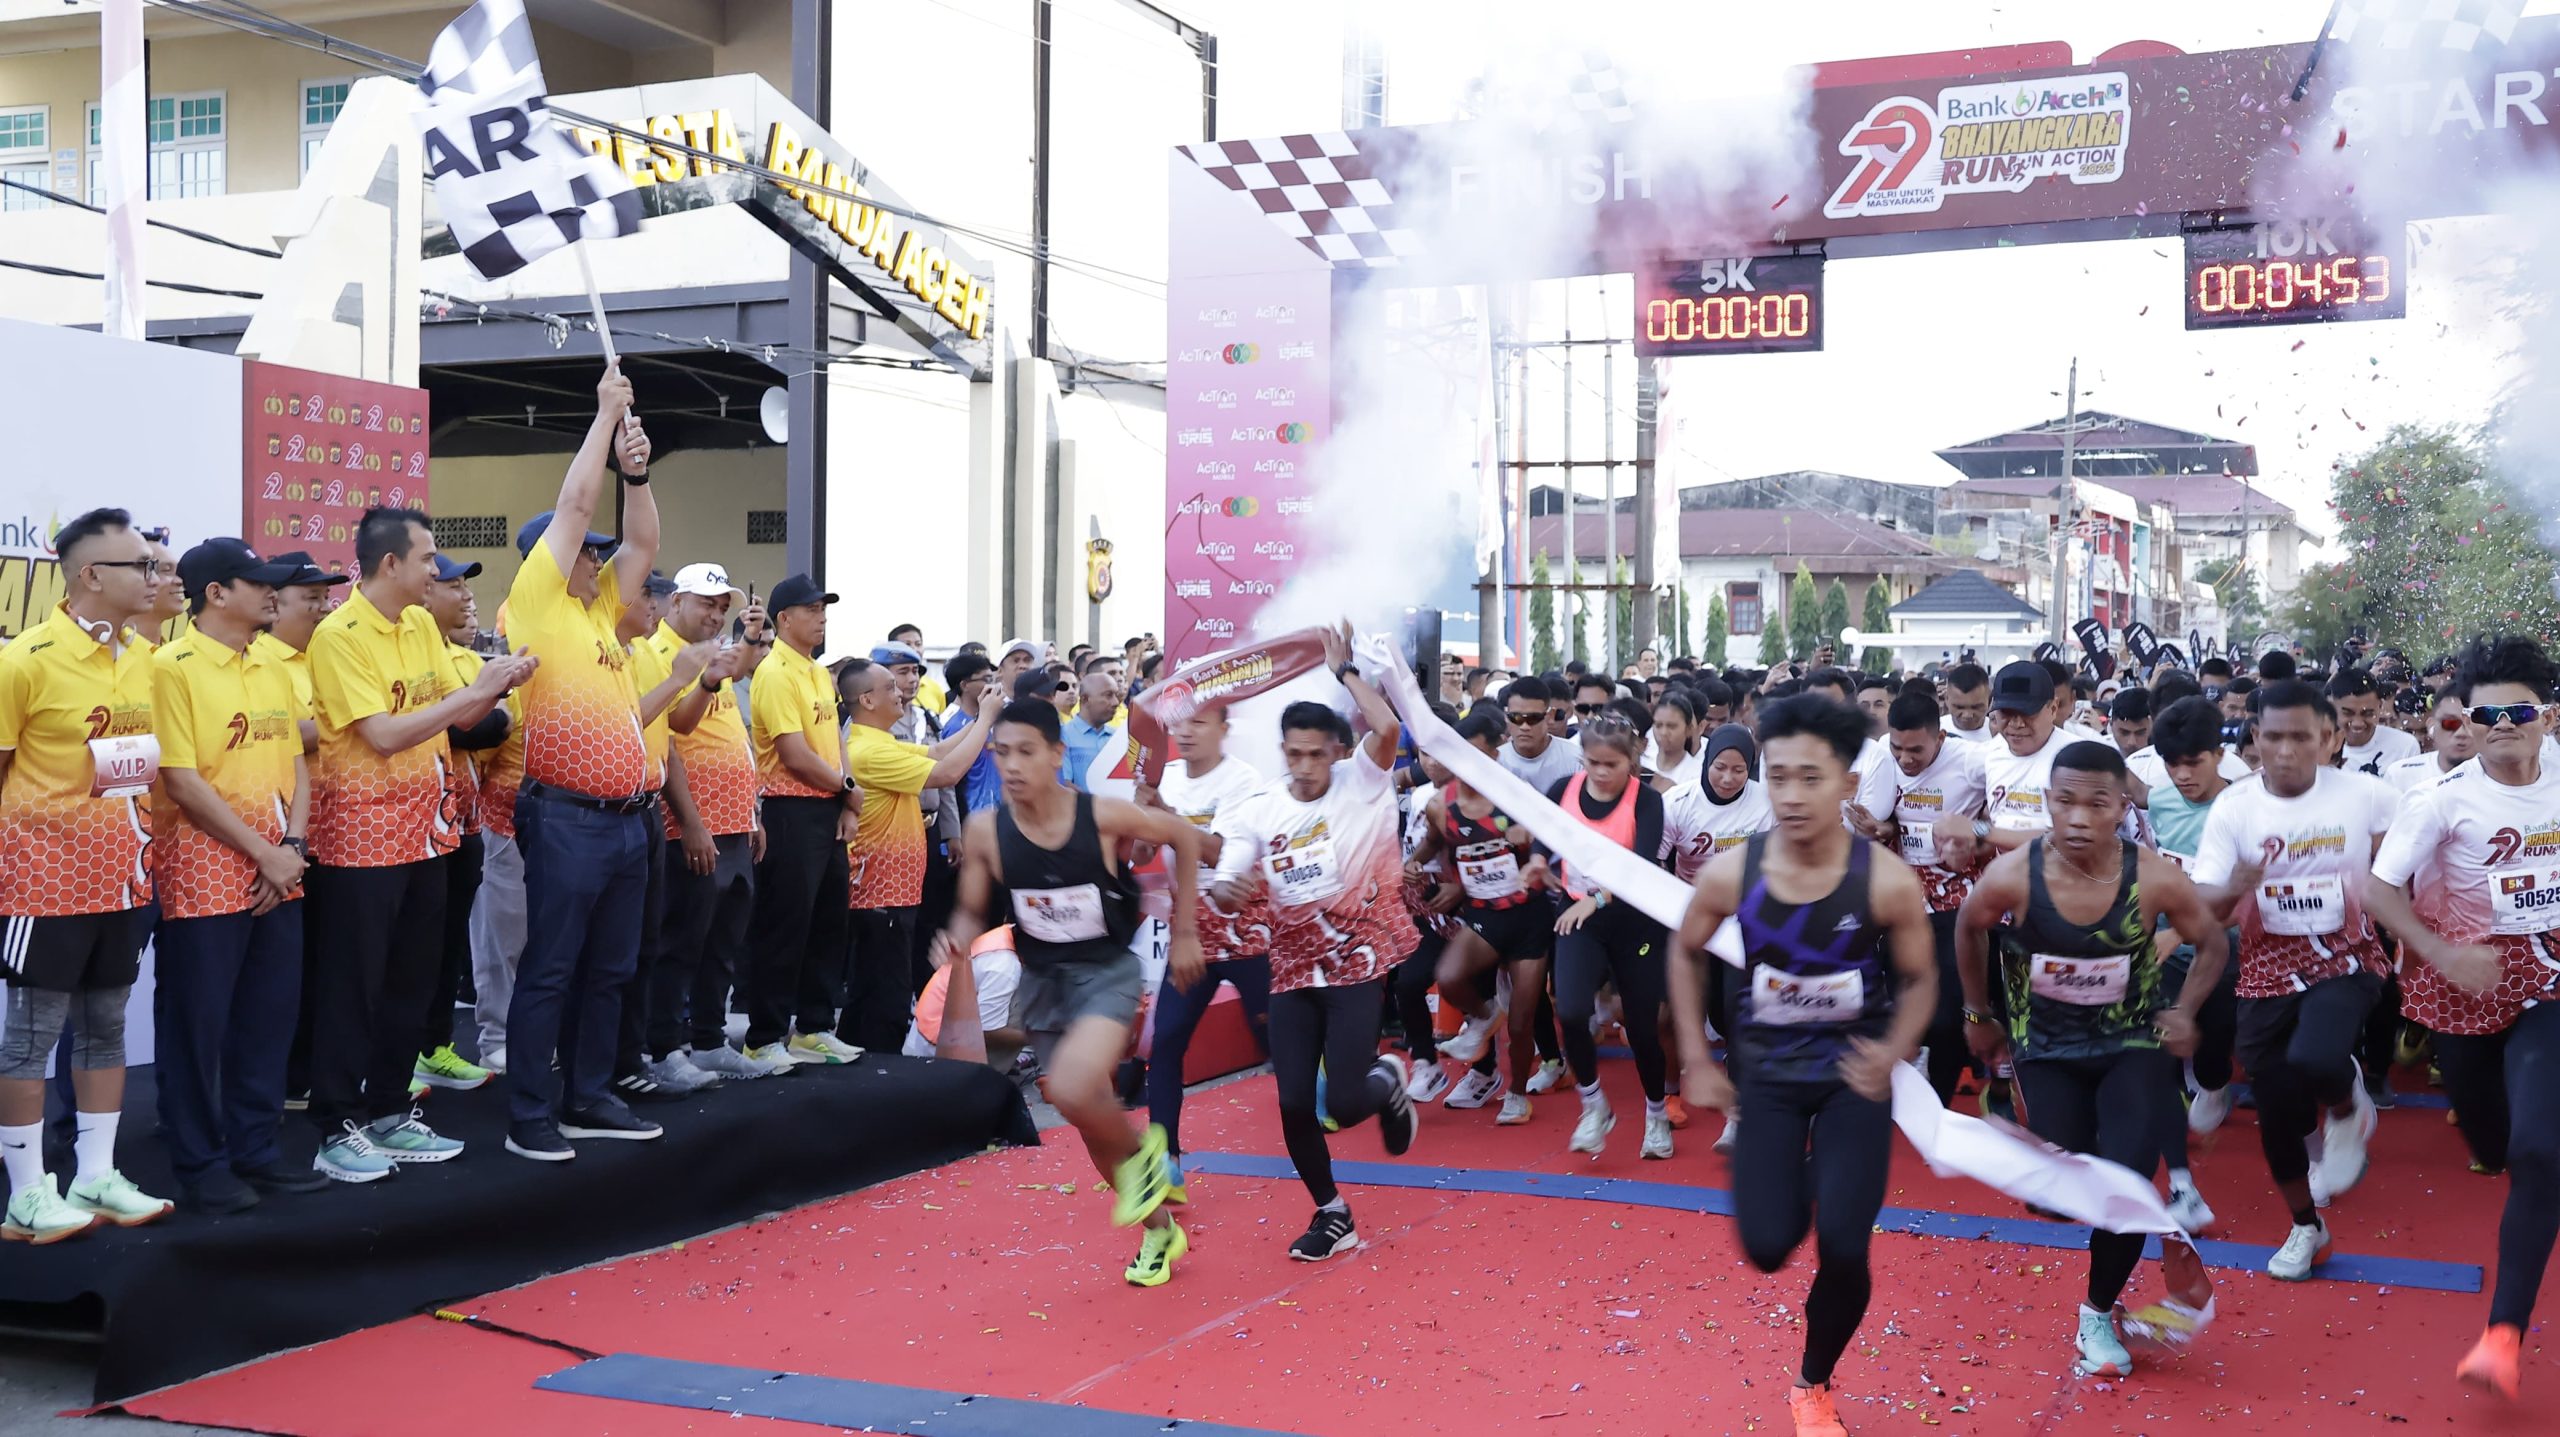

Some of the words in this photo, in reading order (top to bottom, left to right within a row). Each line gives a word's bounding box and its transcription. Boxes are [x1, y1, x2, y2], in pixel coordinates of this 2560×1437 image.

[1948, 96, 2008, 120] Bank
[2036, 87, 2106, 112] Aceh
[2331, 67, 2560, 141] STAR
[2052, 149, 2115, 167] ACTION
[2079, 162, 2115, 177] 2025
[1866, 190, 1897, 200] POLRI
[1899, 187, 1935, 197] UNTUK
[1866, 195, 1936, 208] MASYARAKAT
[764, 121, 895, 270] BANDA
[889, 229, 990, 340] ACEH
[1700, 257, 1756, 294] 5K
[2199, 255, 2391, 312] 00:04:53
[1647, 294, 1809, 342] 00:00:00
[110, 757, 147, 779] VIP
[1902, 835, 1923, 849] 51381
[2508, 878, 2527, 889] 5K
[2514, 888, 2560, 909] 50525
